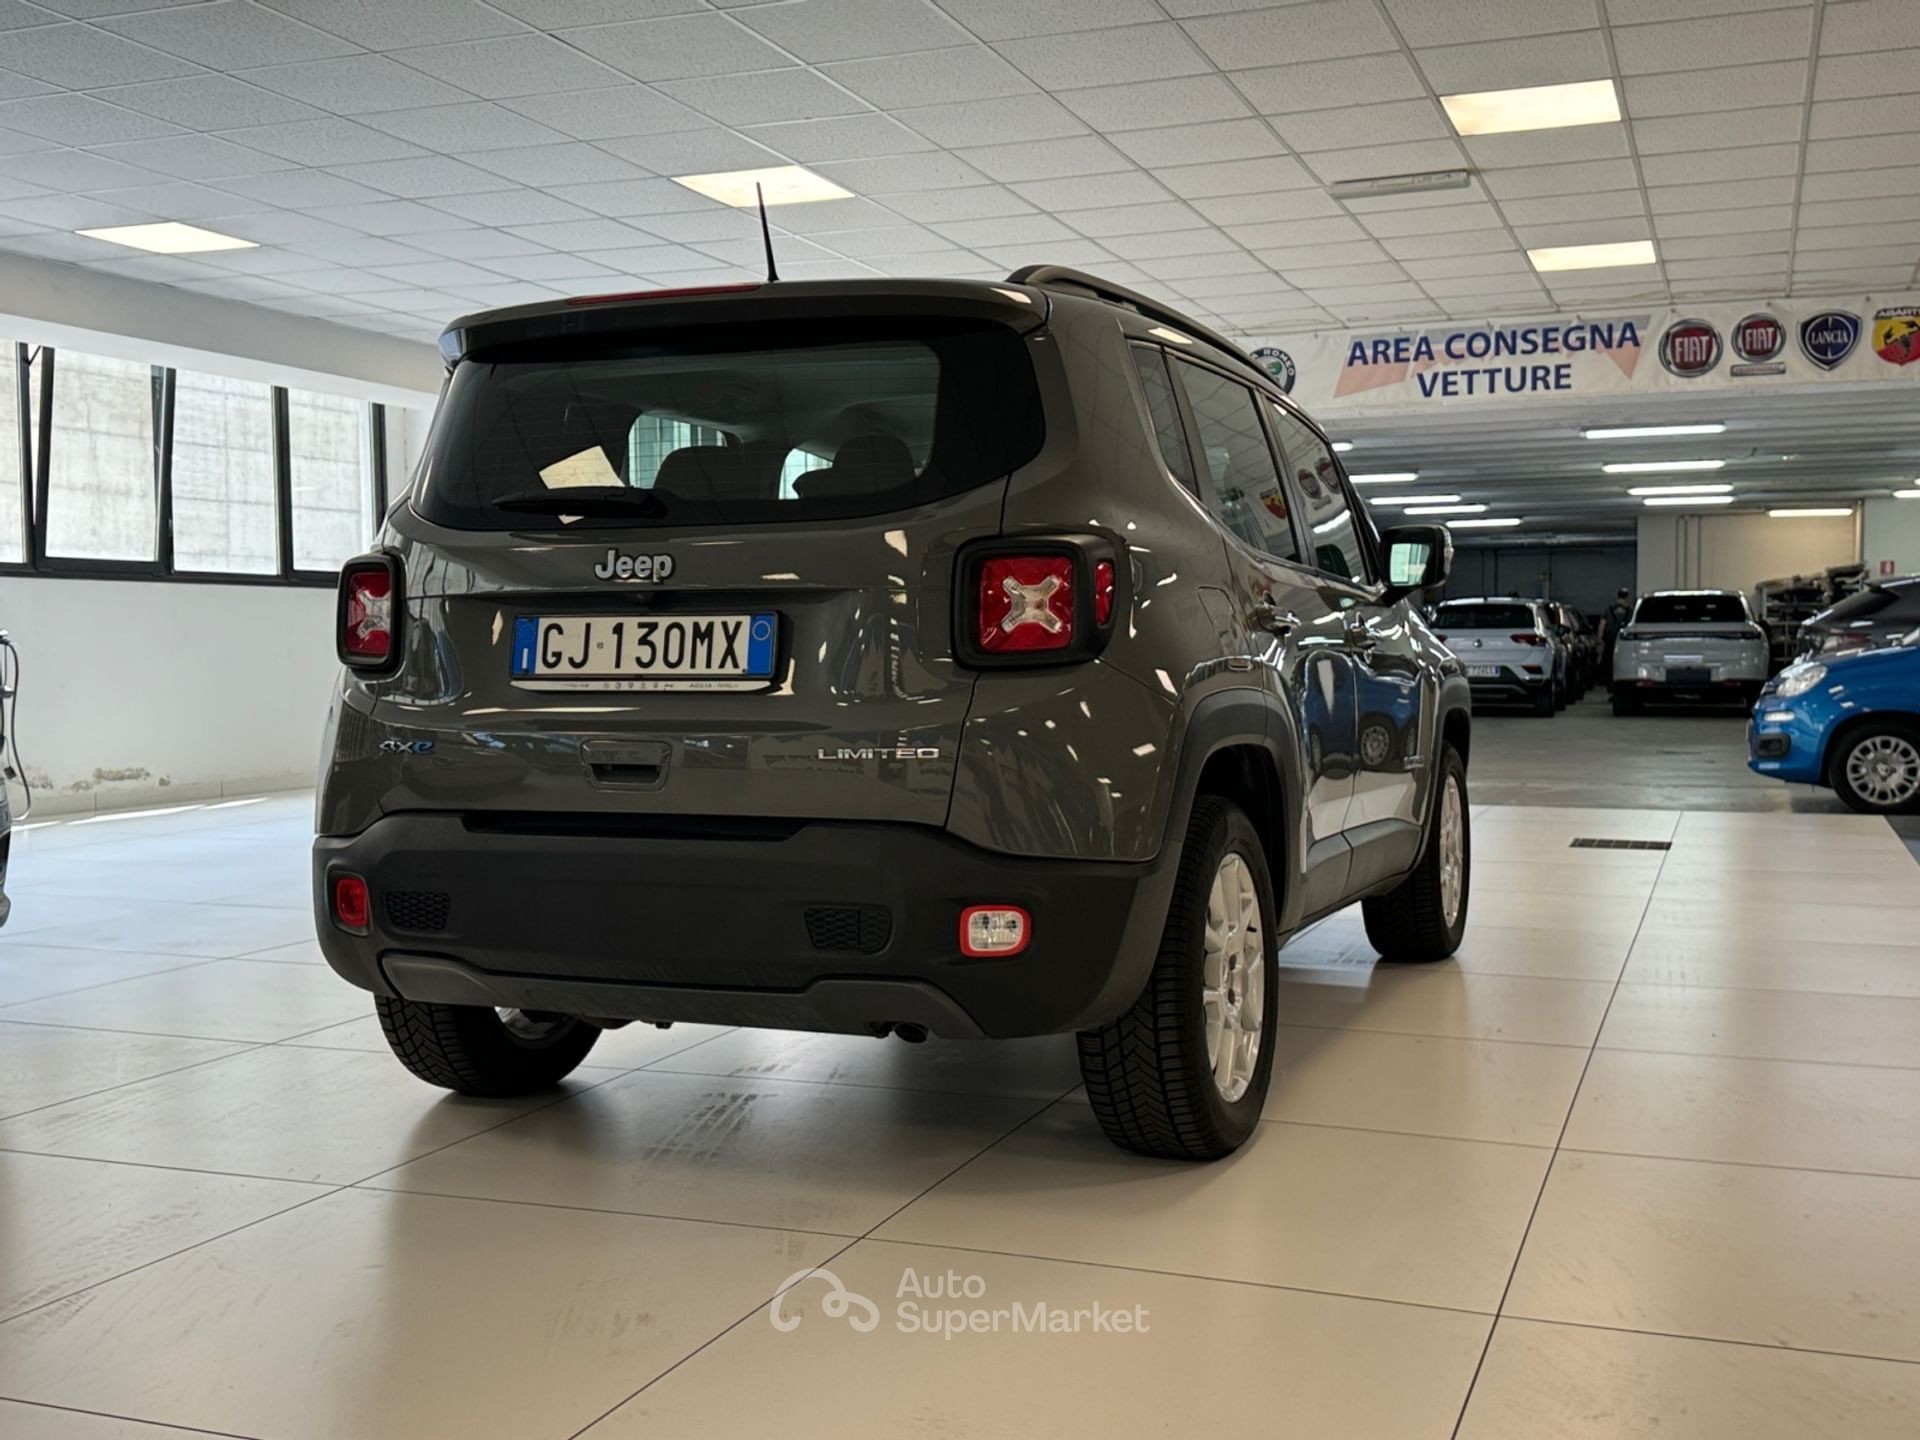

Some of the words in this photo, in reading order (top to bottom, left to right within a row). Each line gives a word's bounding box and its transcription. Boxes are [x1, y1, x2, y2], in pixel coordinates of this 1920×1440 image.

[1876, 307, 1920, 317] ABART
[1347, 335, 1436, 367] AREA
[1444, 321, 1641, 360] CONSEGNA
[1675, 336, 1709, 363] FIAT
[1745, 327, 1775, 349] FIAT
[1811, 329, 1849, 345] LANCIA
[1263, 348, 1295, 376] ROMEO
[1417, 363, 1573, 398] VETTURE
[594, 548, 673, 583] Jeep
[541, 622, 592, 670] GJ
[611, 620, 743, 669] 130MX
[817, 747, 940, 760] LIMITED
